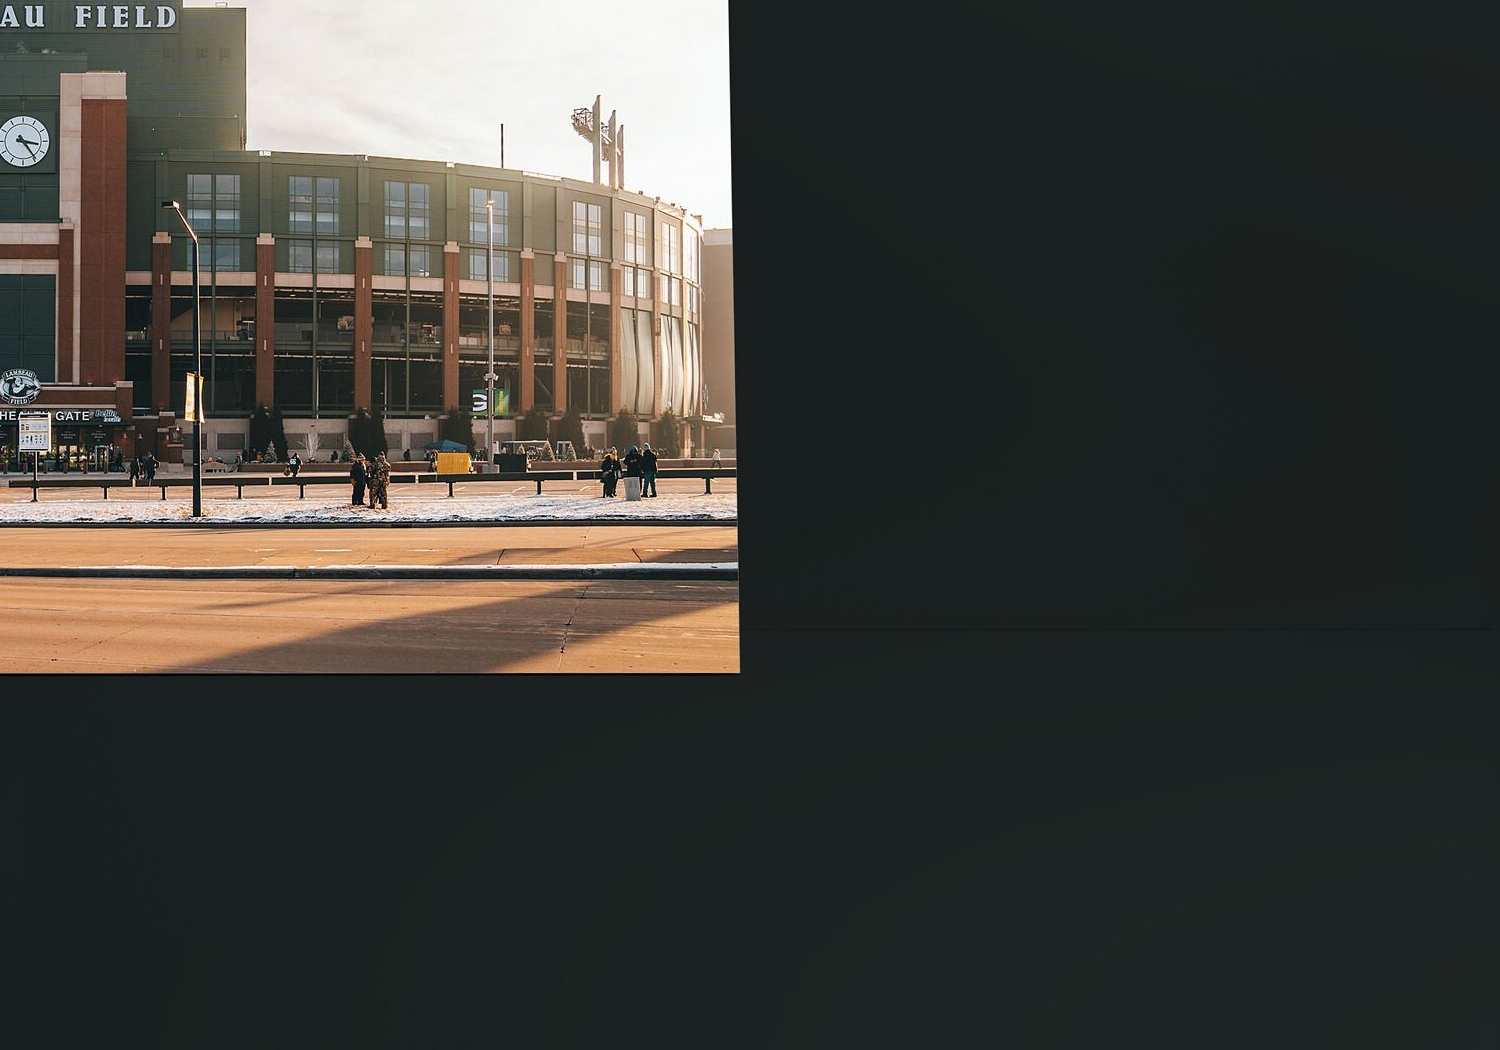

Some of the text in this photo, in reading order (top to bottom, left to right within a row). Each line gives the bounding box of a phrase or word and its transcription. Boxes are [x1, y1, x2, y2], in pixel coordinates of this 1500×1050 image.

[75, 5, 176, 28] FIELD
[5, 370, 33, 378] LAMBEAU
[55, 411, 90, 421] GATE
